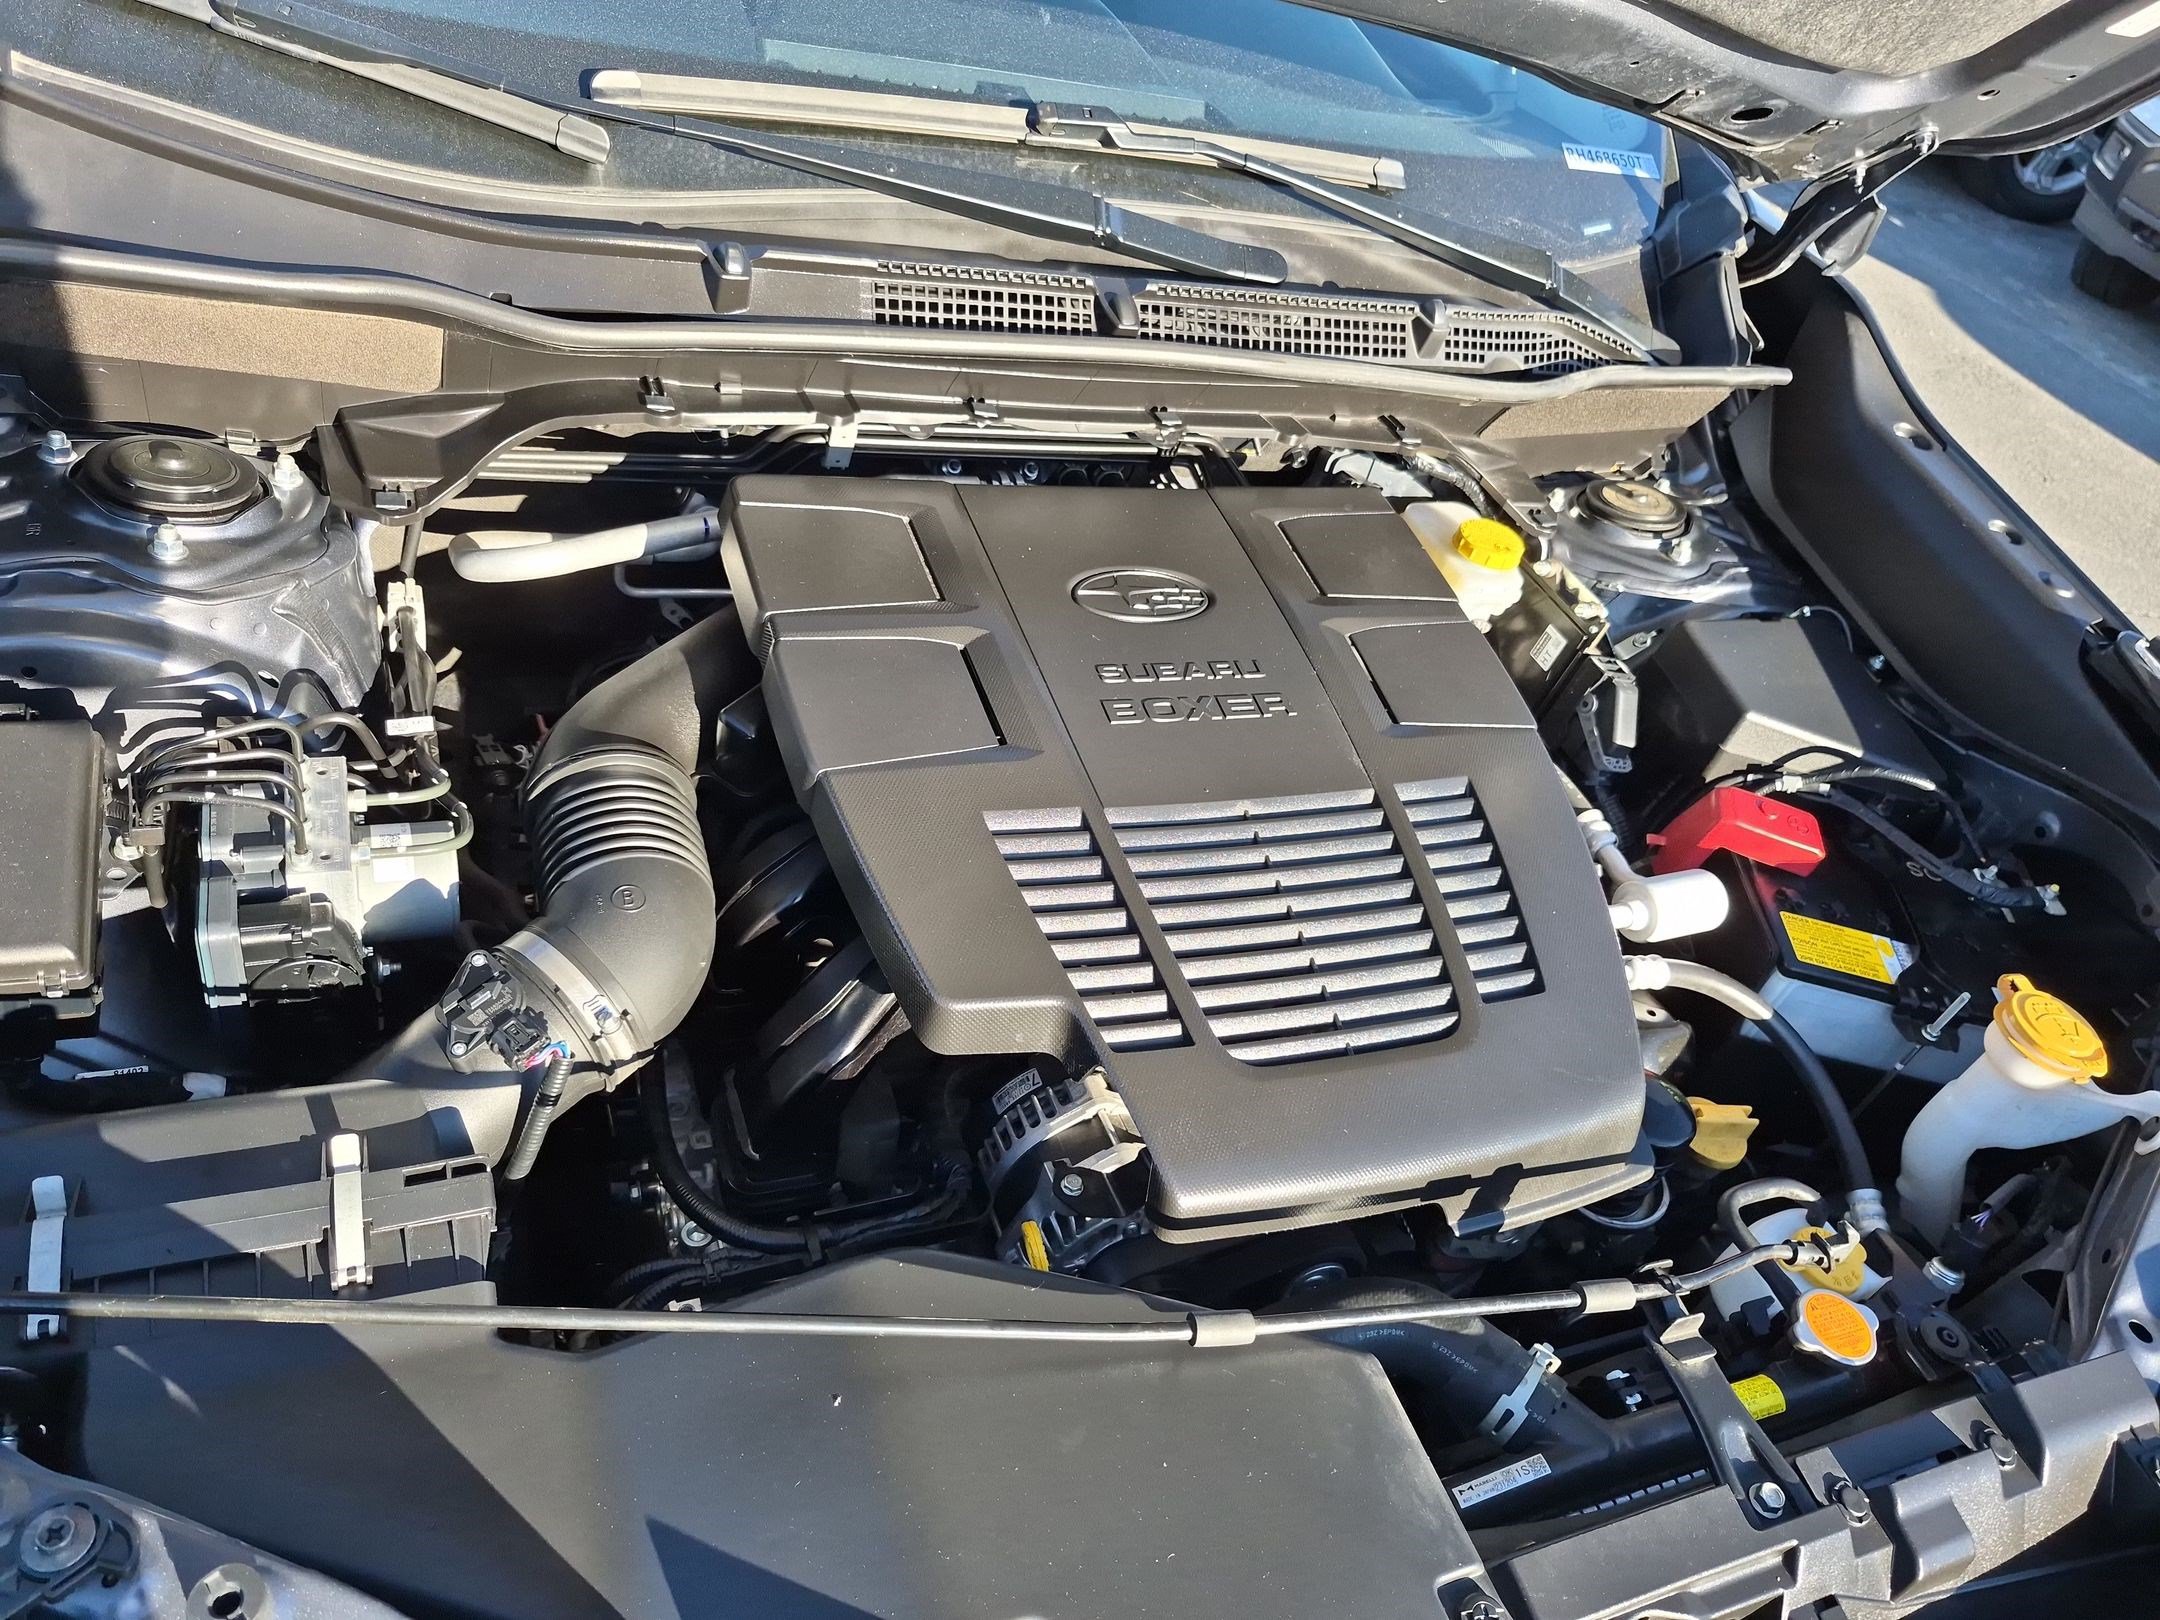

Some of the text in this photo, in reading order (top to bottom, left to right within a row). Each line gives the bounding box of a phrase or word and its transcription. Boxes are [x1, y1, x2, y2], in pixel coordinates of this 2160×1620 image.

[1095, 659, 1266, 683] SUBARU
[1100, 692, 1297, 724] BOXER
[622, 890, 633, 907] B
[1474, 1476, 1498, 1488] MARELLI
